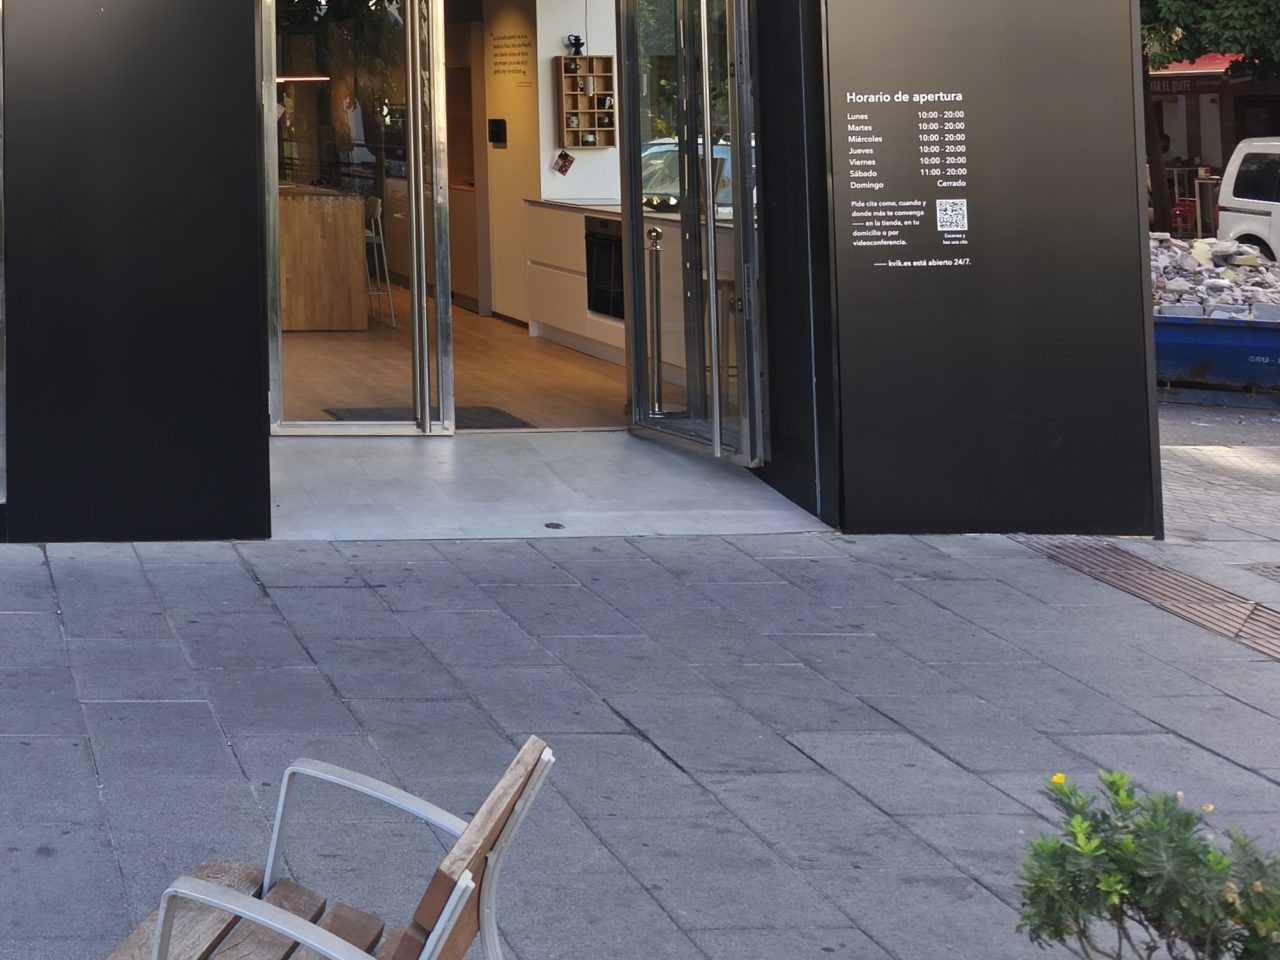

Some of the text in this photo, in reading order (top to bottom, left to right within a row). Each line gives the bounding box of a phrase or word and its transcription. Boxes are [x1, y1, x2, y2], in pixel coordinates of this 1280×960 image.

[846, 91, 963, 104] Horario de apertura
[918, 111, 938, 119] 10:00
[918, 122, 939, 130] 10:00
[944, 122, 965, 130] 20:00
[848, 135, 883, 143] Miércoles
[918, 134, 939, 142] 10:00
[944, 133, 966, 141] 20:00
[848, 147, 874, 155] Jueves
[919, 145, 940, 153] 10:00
[849, 158, 876, 166] Viernes
[919, 157, 940, 165] 10:00
[945, 156, 967, 164] 20:00
[849, 170, 877, 178] Sábado
[920, 168, 941, 176] 11:00
[946, 167, 967, 175] 20:00
[850, 179, 967, 190] Domingo Cerrado
[894, 210, 925, 218] convenga
[881, 219, 903, 227] tienda,
[888, 259, 912, 267] kvik.es
[953, 258, 972, 266] 24/7.
